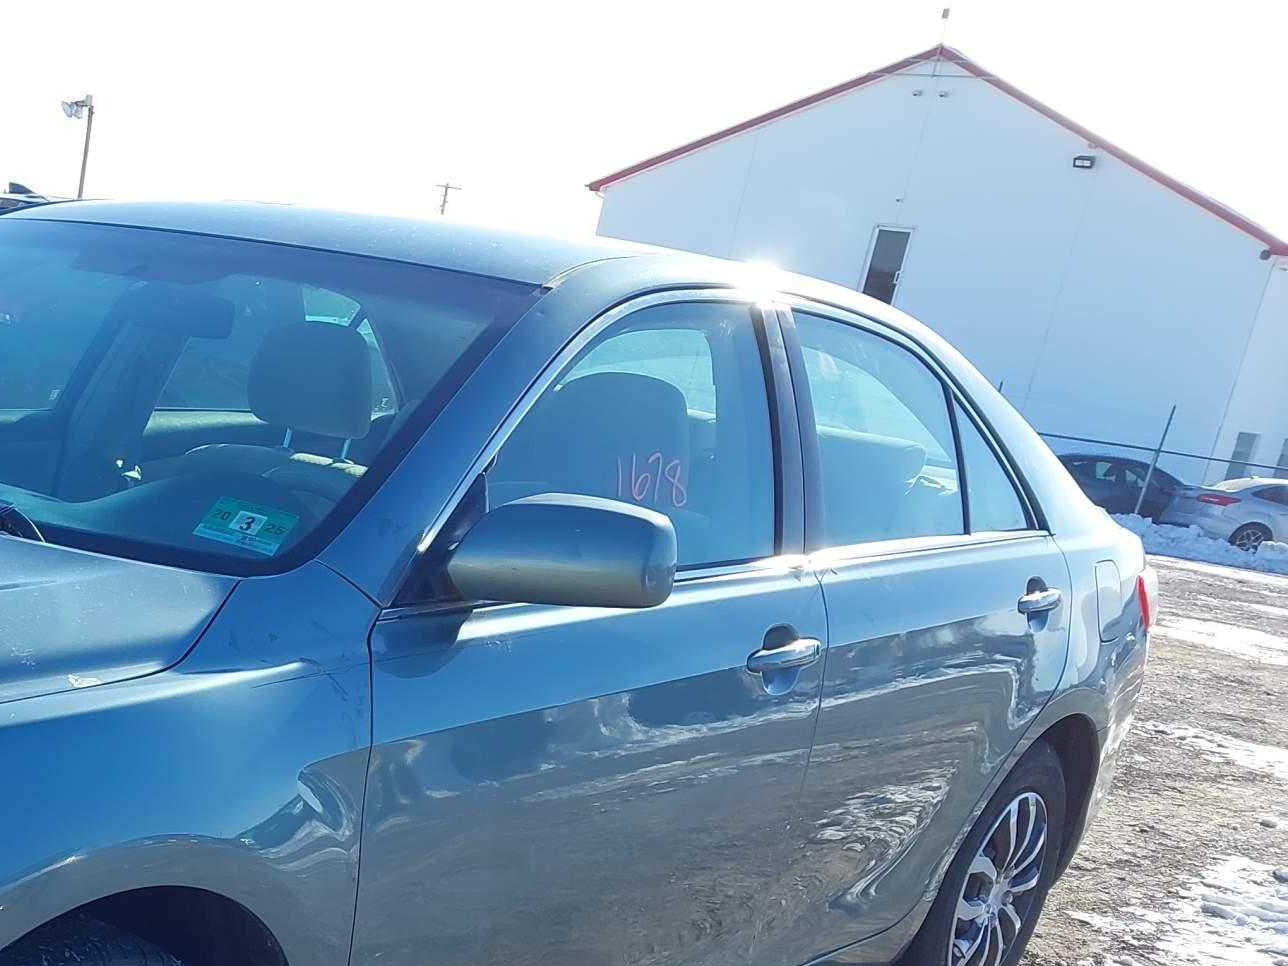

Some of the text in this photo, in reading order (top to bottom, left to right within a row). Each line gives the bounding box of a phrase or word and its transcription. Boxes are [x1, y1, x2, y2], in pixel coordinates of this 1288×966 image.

[617, 452, 687, 507] 1678
[213, 509, 287, 536] 20 3 25
